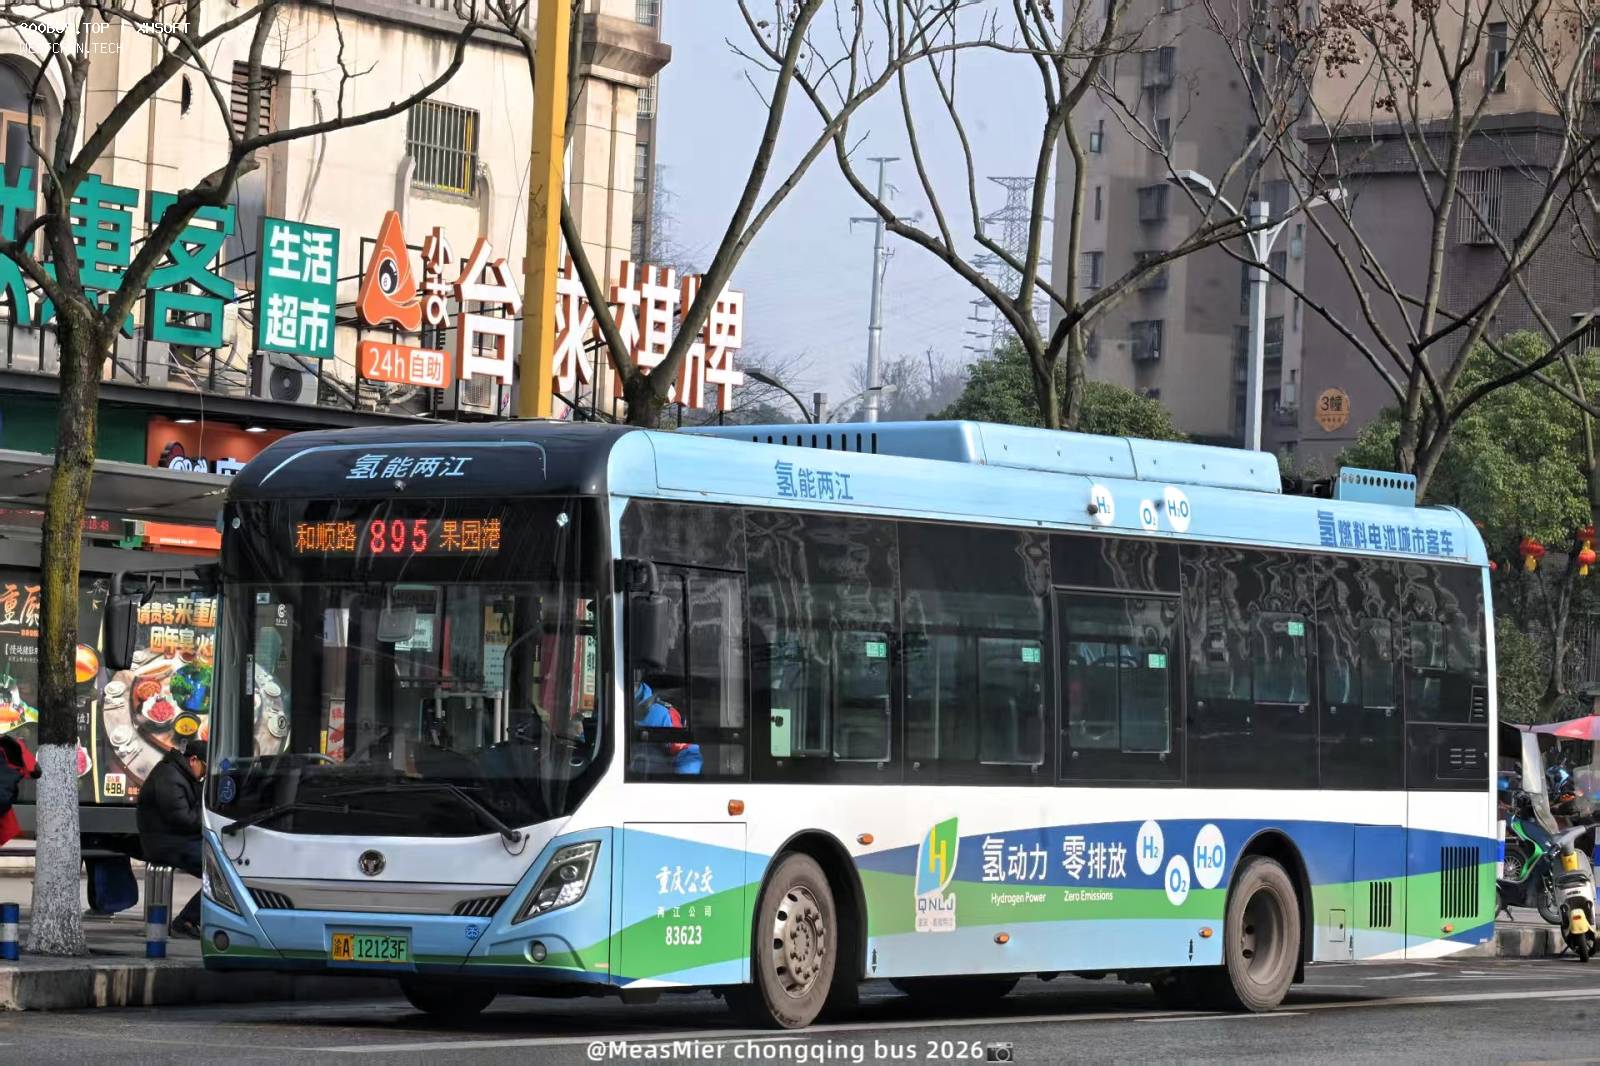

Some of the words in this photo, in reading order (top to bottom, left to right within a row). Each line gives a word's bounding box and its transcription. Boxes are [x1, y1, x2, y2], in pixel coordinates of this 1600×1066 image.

[268, 225, 332, 285] 生活
[265, 293, 330, 351] 超市
[369, 347, 405, 379] 24h
[412, 353, 441, 381] 自助
[346, 454, 472, 479] 氢能两江
[774, 459, 854, 500] 氢能两江
[295, 522, 357, 553] 和顺路
[370, 519, 428, 553] 895
[440, 518, 501, 551] 果园港
[1317, 509, 1453, 556] 氢燃料电池城市客车
[982, 835, 1048, 882] 氢动力
[1062, 835, 1127, 881] 零排放
[655, 865, 715, 895] 重庆公交
[991, 893, 1024, 906] Hydrogen
[1026, 891, 1046, 903] Power
[1064, 890, 1080, 902] Zero
[1081, 889, 1114, 901] Emissions
[665, 925, 702, 945] 83623
